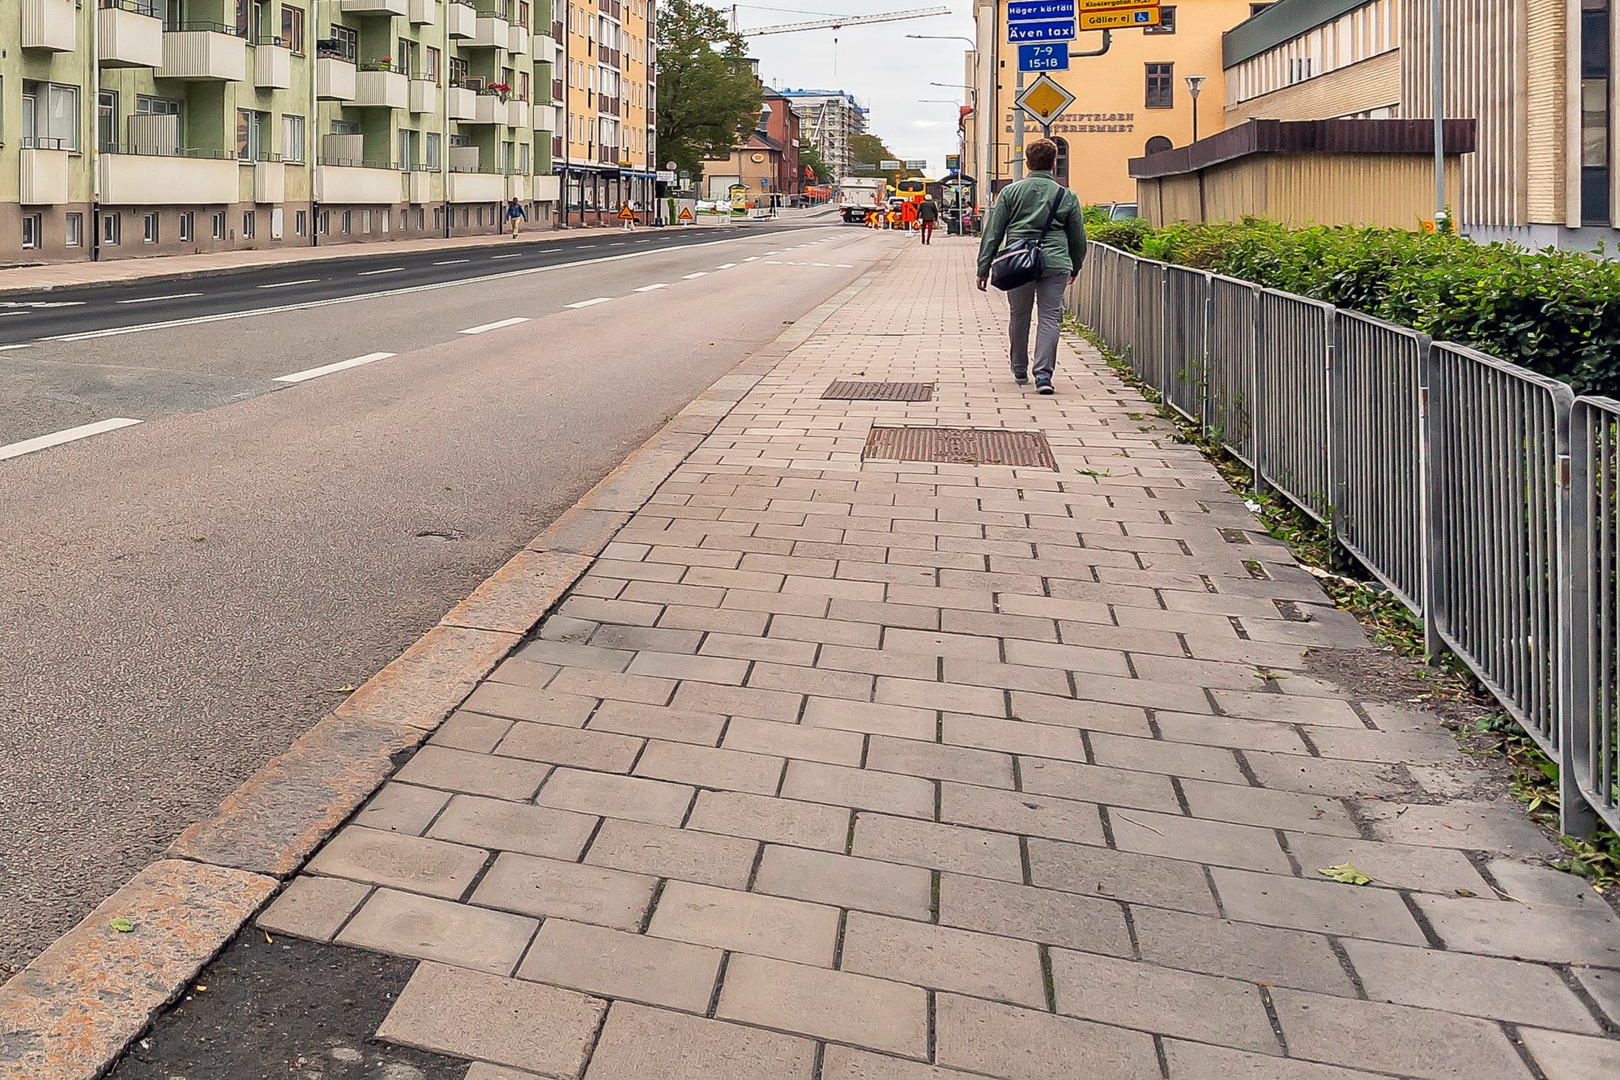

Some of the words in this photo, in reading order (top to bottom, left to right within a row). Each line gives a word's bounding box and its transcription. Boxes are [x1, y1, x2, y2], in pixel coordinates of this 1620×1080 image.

[1009, 7, 1037, 15] Höger
[1040, 4, 1073, 13] körfält
[1089, 16, 1118, 24] Gäller
[1121, 14, 1130, 23] ej
[1010, 26, 1043, 38] Även
[1048, 26, 1074, 36] taxi
[1033, 46, 1053, 56] 7-9
[1029, 58, 1058, 68] 15-18
